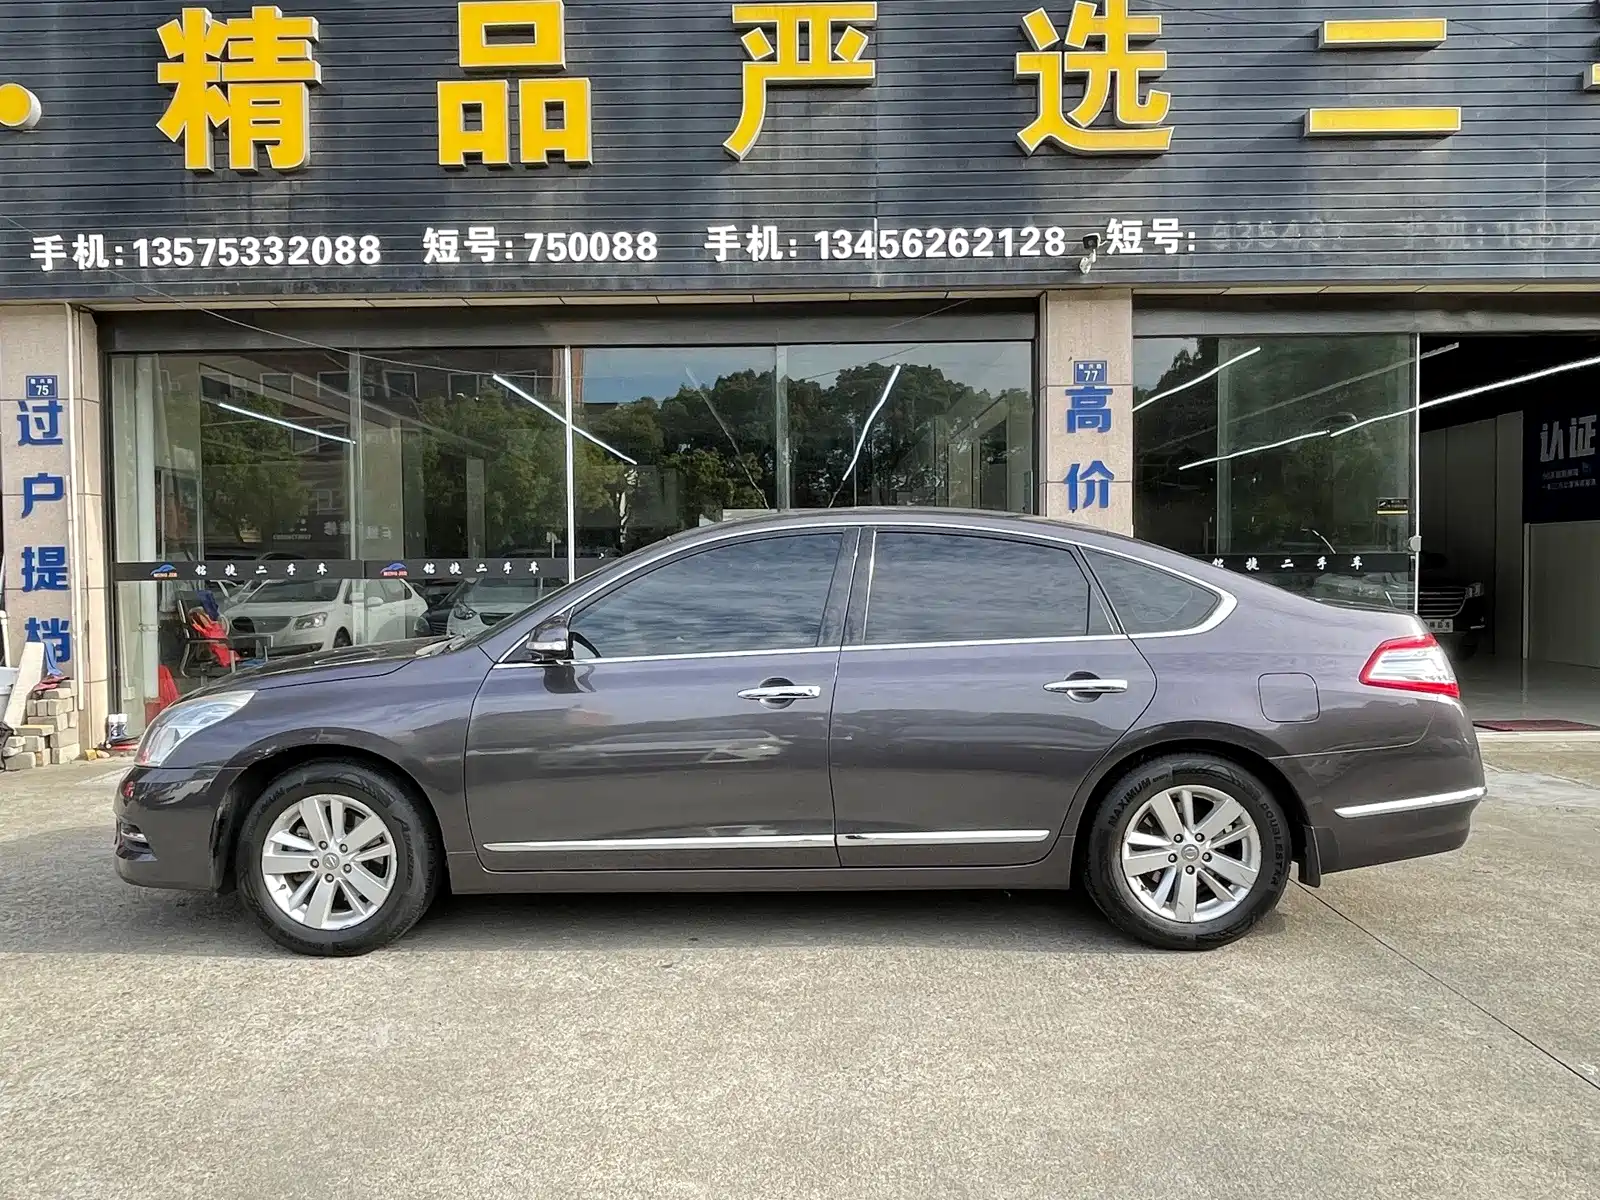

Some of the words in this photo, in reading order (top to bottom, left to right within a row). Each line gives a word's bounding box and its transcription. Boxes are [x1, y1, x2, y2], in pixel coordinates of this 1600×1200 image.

[156, 0, 1600, 170] 精品严选二
[36, 385, 49, 396] 75
[1084, 370, 1098, 381] 77
[1064, 385, 1116, 513] 高价
[1540, 414, 1597, 463] 认证
[1108, 777, 1151, 828] MAXIMUM
